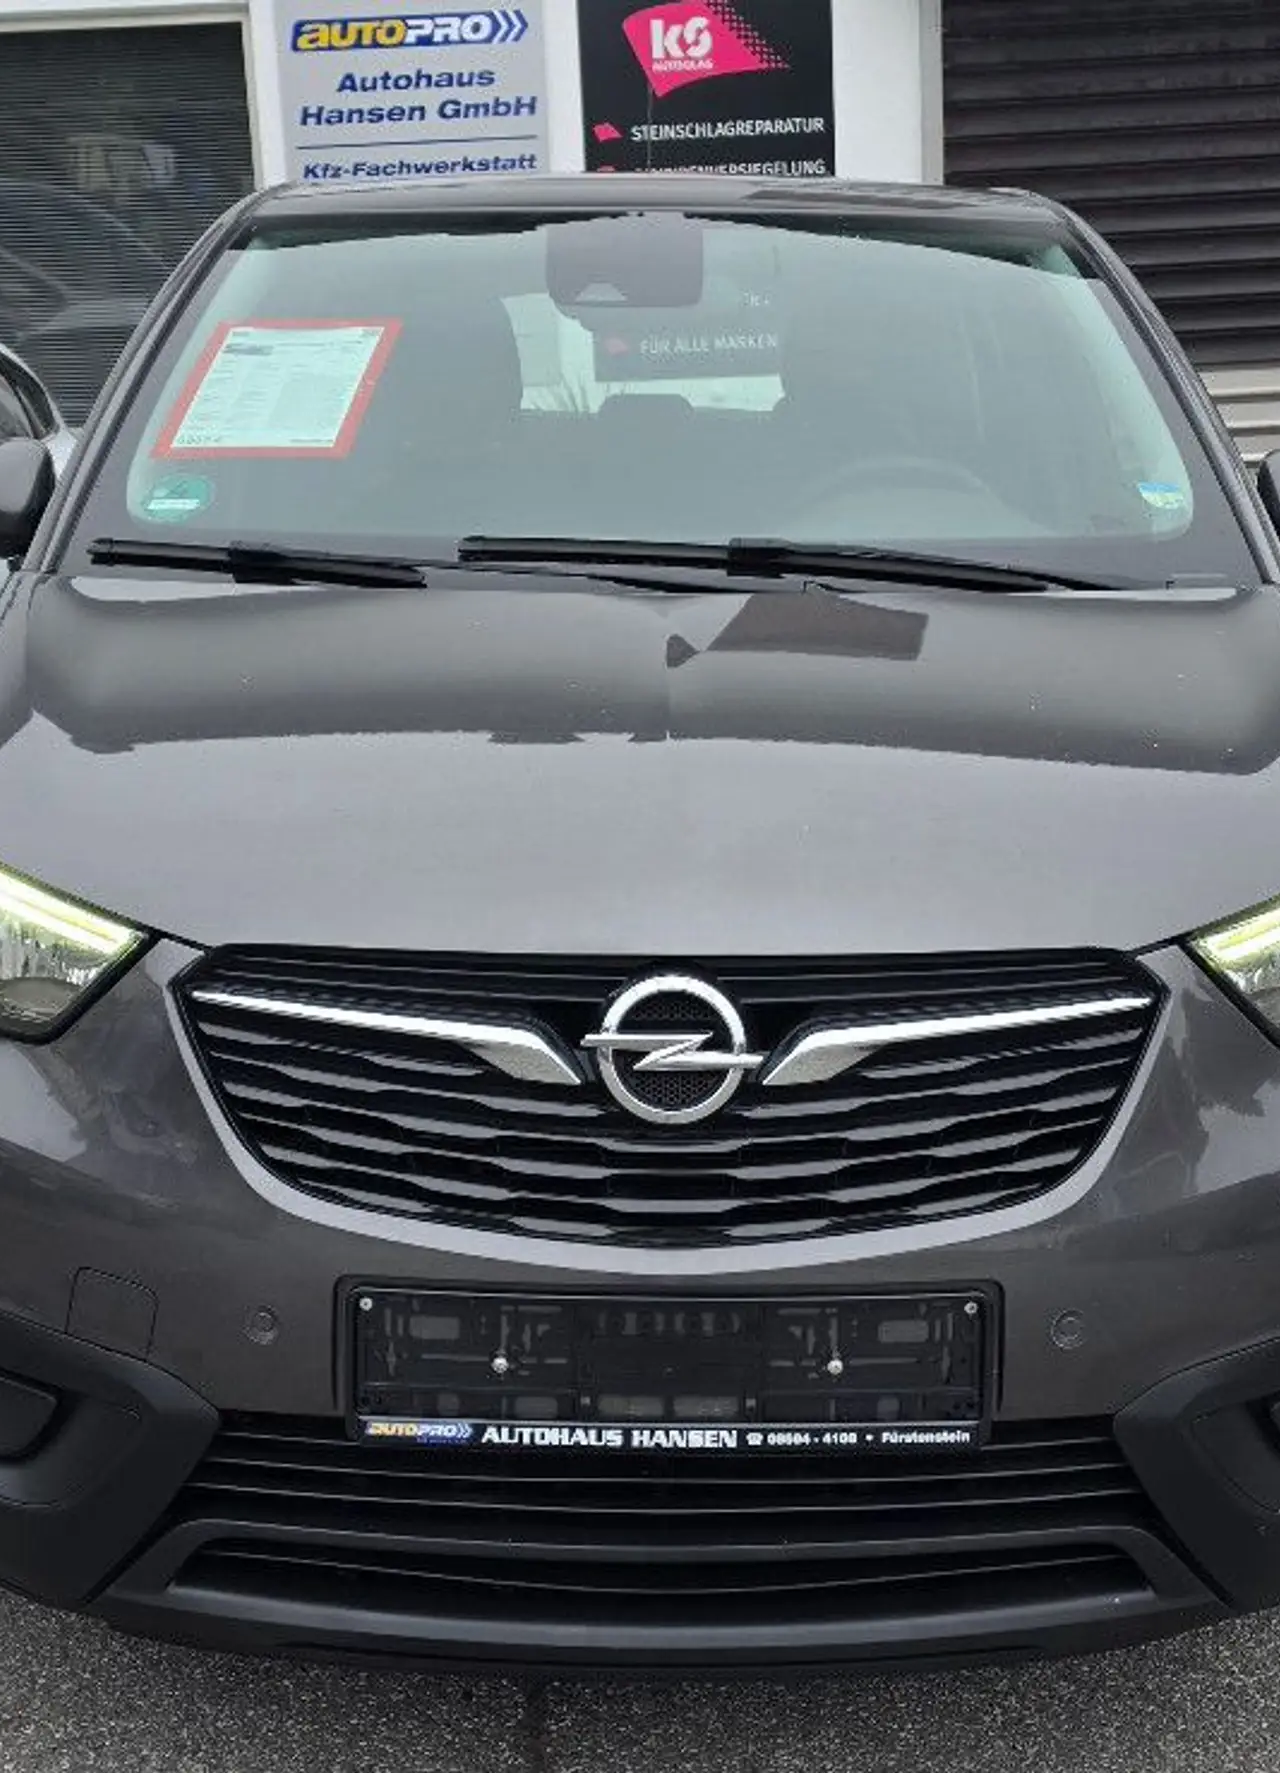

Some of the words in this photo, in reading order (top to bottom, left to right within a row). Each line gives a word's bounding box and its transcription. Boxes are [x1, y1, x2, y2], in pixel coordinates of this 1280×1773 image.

[336, 69, 496, 92] Autohaus
[299, 103, 426, 126] Hansen
[437, 96, 537, 119] GmbH
[631, 117, 825, 141] STEINSCHLAGREPARATUR
[303, 154, 537, 179] Kfz-Fachwerkstatt
[481, 1427, 624, 1446] AUTOHAUS
[631, 1429, 738, 1448] HANSEN
